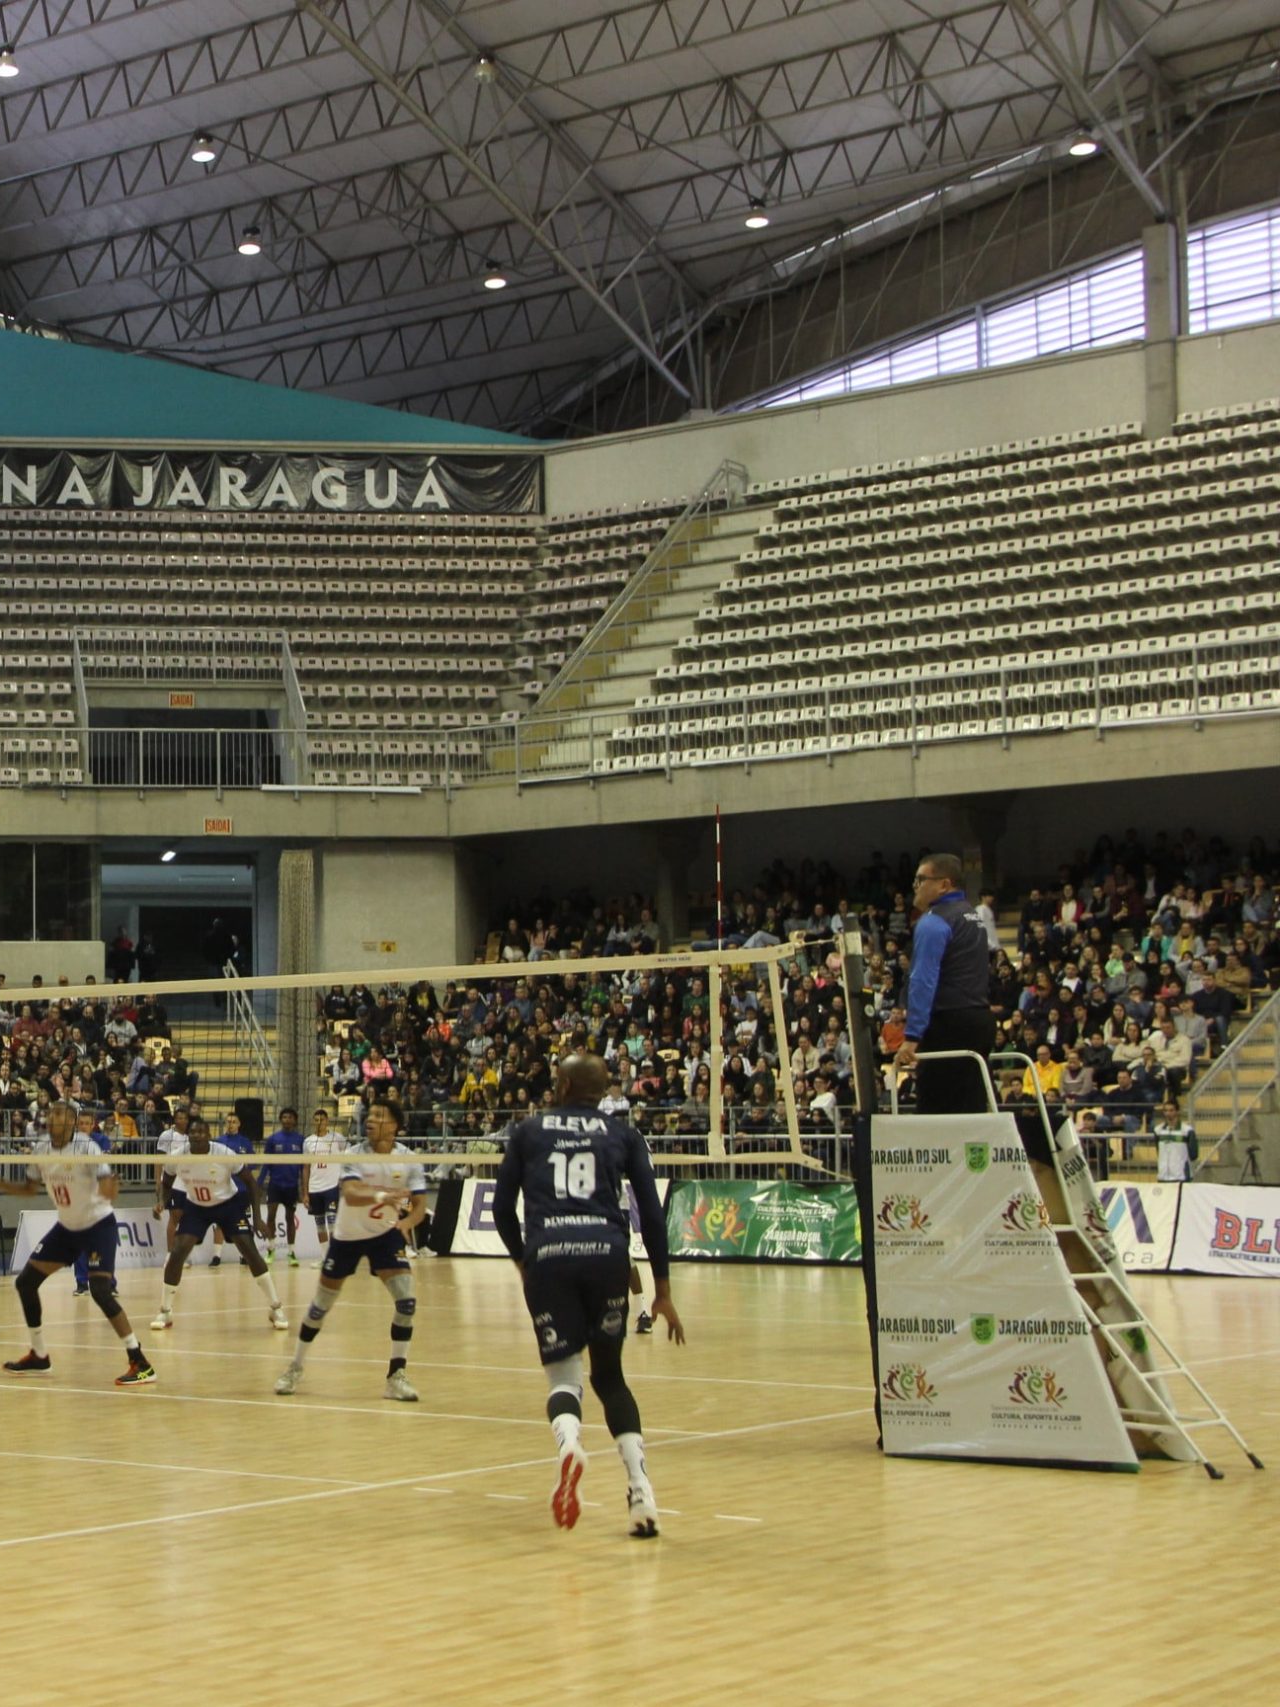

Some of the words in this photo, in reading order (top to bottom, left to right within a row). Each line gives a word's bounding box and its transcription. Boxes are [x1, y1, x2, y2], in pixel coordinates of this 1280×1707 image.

[132, 455, 451, 509] JARAGUÁ
[542, 1115, 608, 1132] ELEVA
[931, 1148, 951, 1164] SUL
[547, 1152, 596, 1199] 18
[1211, 1207, 1280, 1255] BL
[922, 1318, 935, 1334] DO
[999, 1318, 1048, 1334] JARAGUÁ
[1051, 1320, 1065, 1335] DO
[1067, 1321, 1088, 1336] SUL
